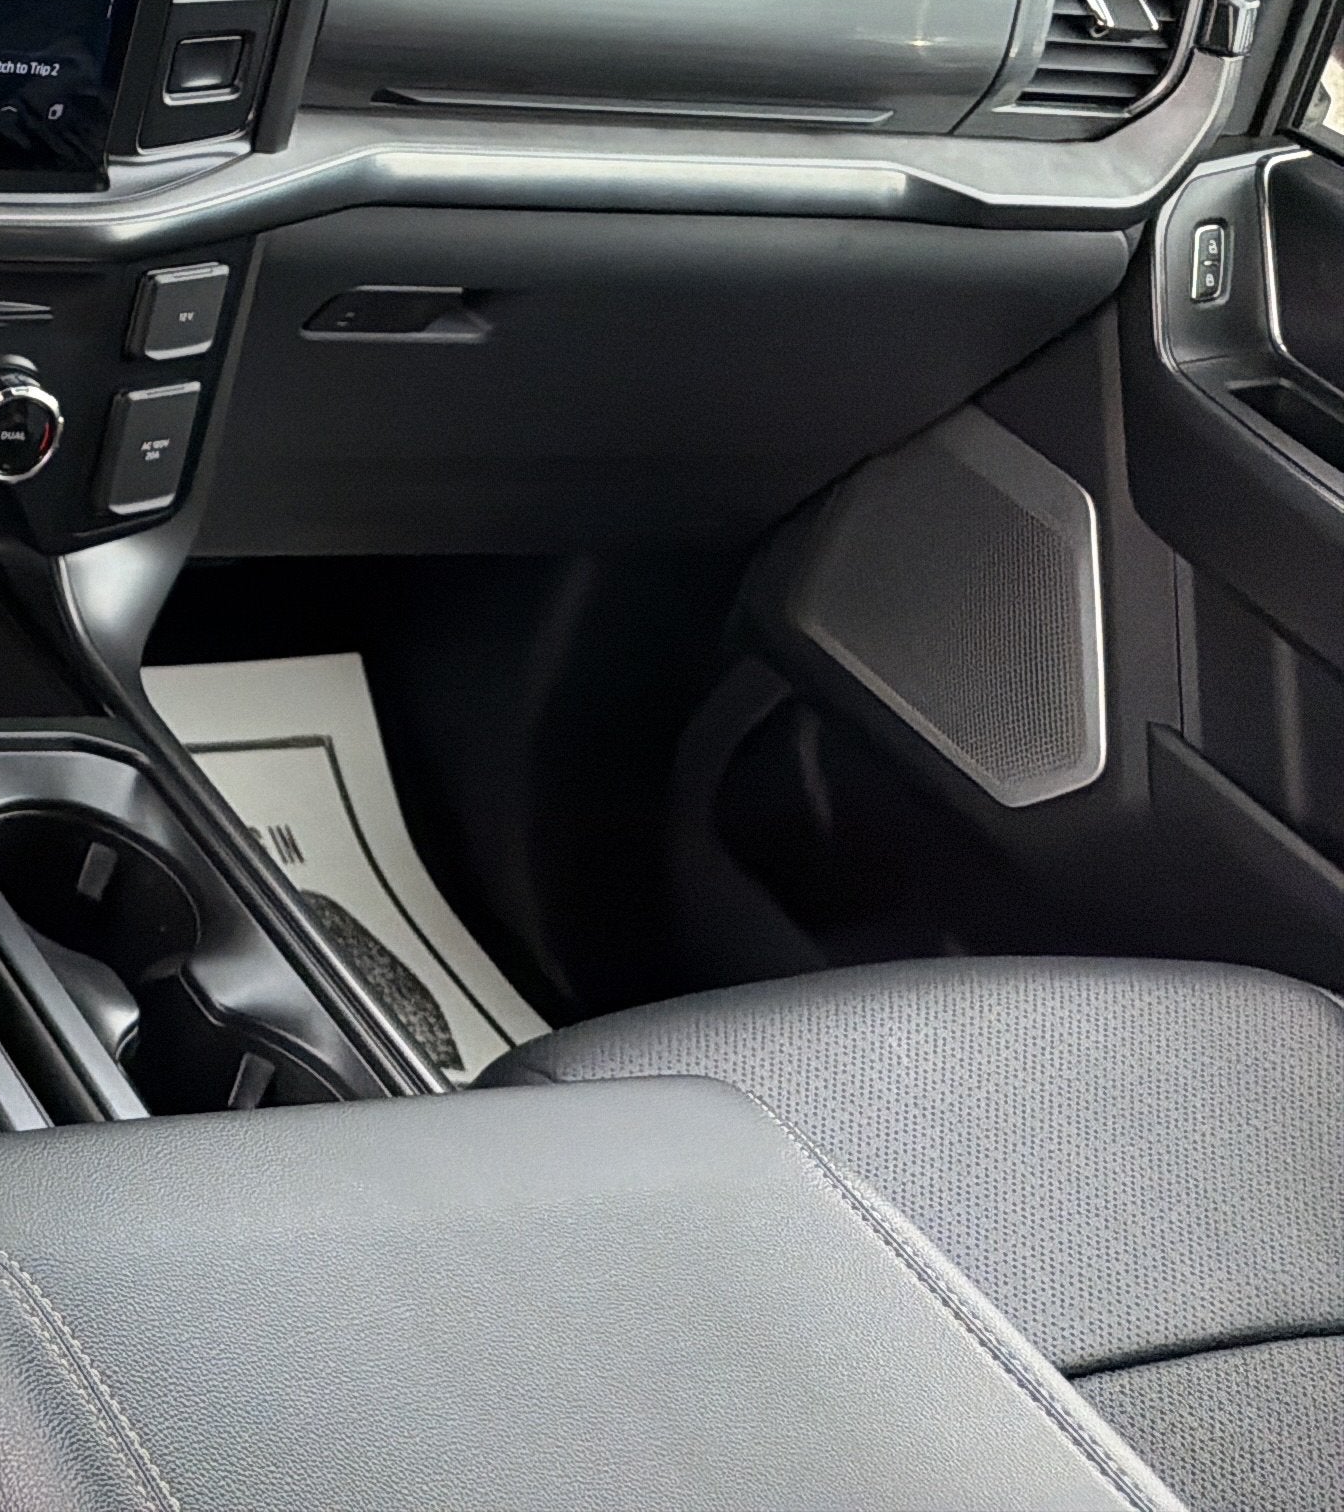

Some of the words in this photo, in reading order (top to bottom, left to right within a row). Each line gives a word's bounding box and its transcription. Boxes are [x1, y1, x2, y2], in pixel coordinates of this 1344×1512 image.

[16, 62, 28, 74] to
[30, 62, 51, 76] Trip
[51, 63, 60, 76] 2
[1, 431, 25, 440] DUAL
